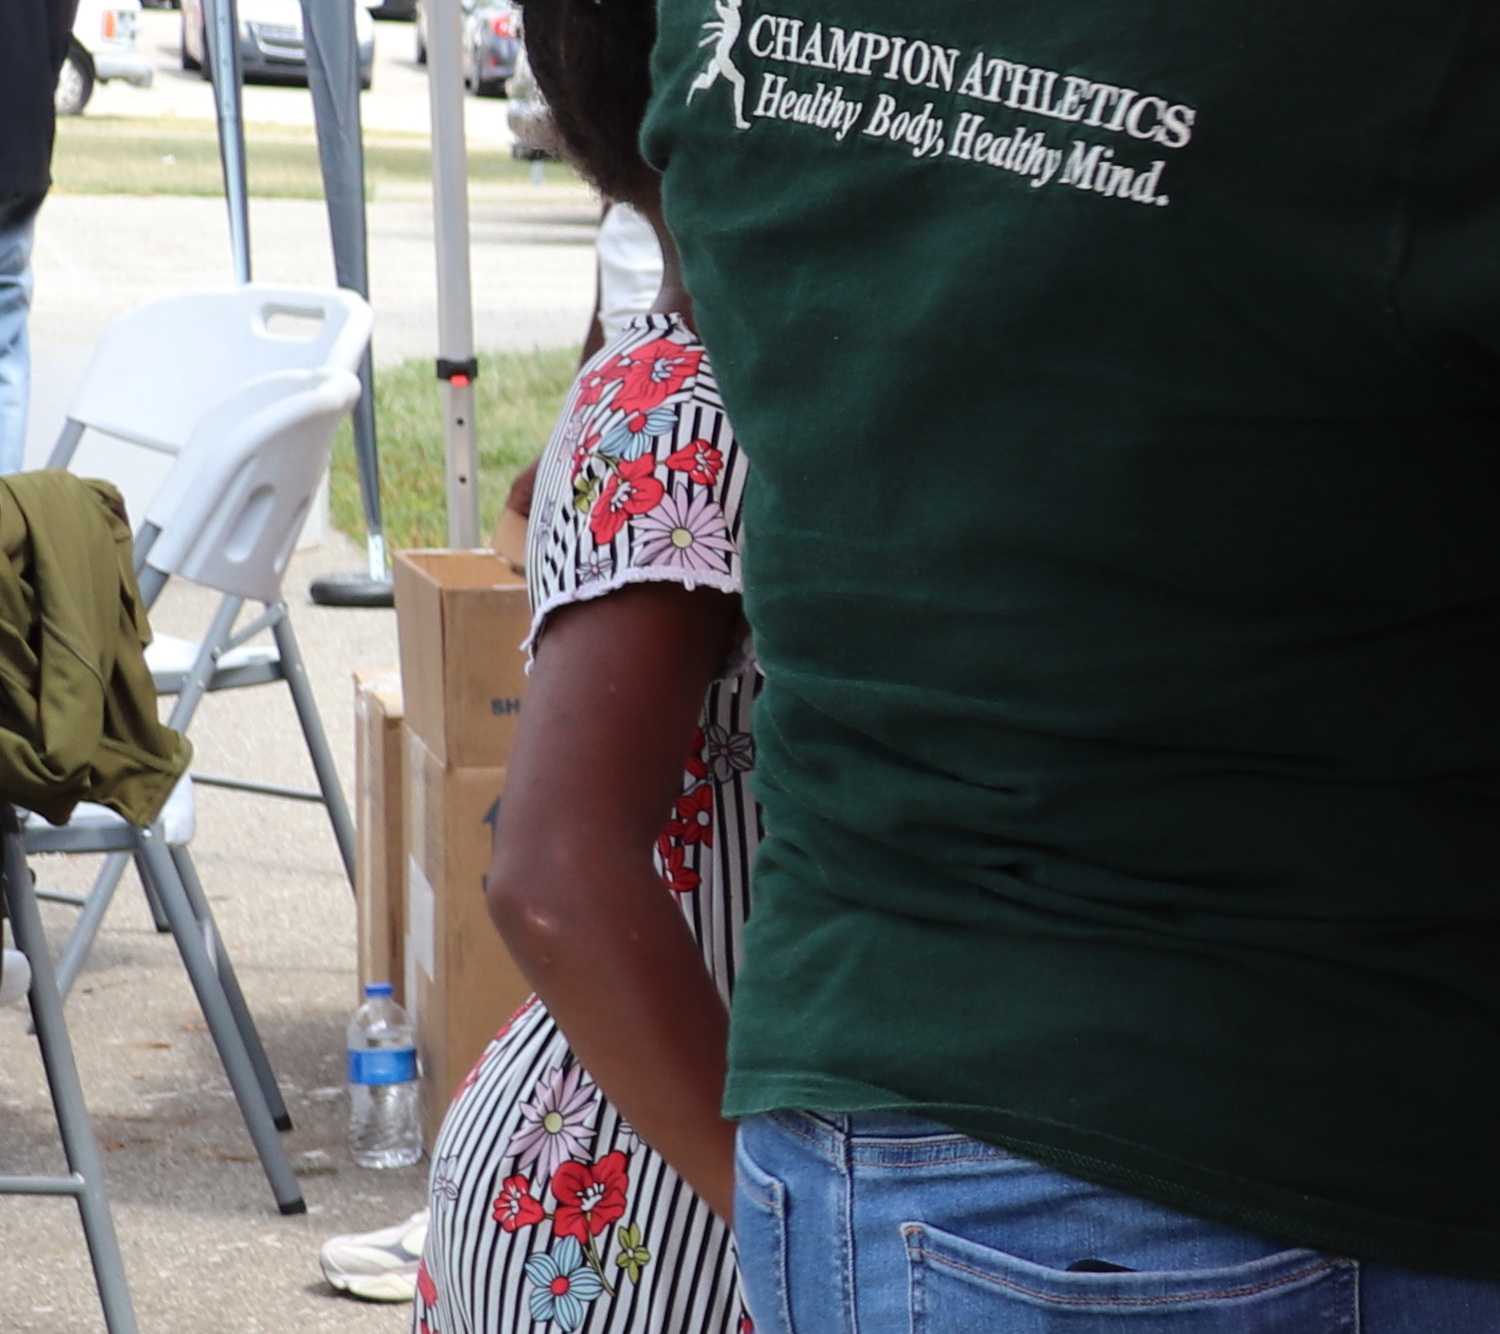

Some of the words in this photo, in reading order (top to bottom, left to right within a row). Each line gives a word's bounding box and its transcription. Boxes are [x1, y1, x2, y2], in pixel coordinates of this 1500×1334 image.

[748, 14, 960, 92] CHAMPION
[958, 51, 1197, 148] ATHLETICS
[753, 73, 862, 140] Healthy
[863, 94, 946, 157] Body,
[949, 113, 1062, 188] Healthy
[1058, 141, 1170, 207] Mind.
